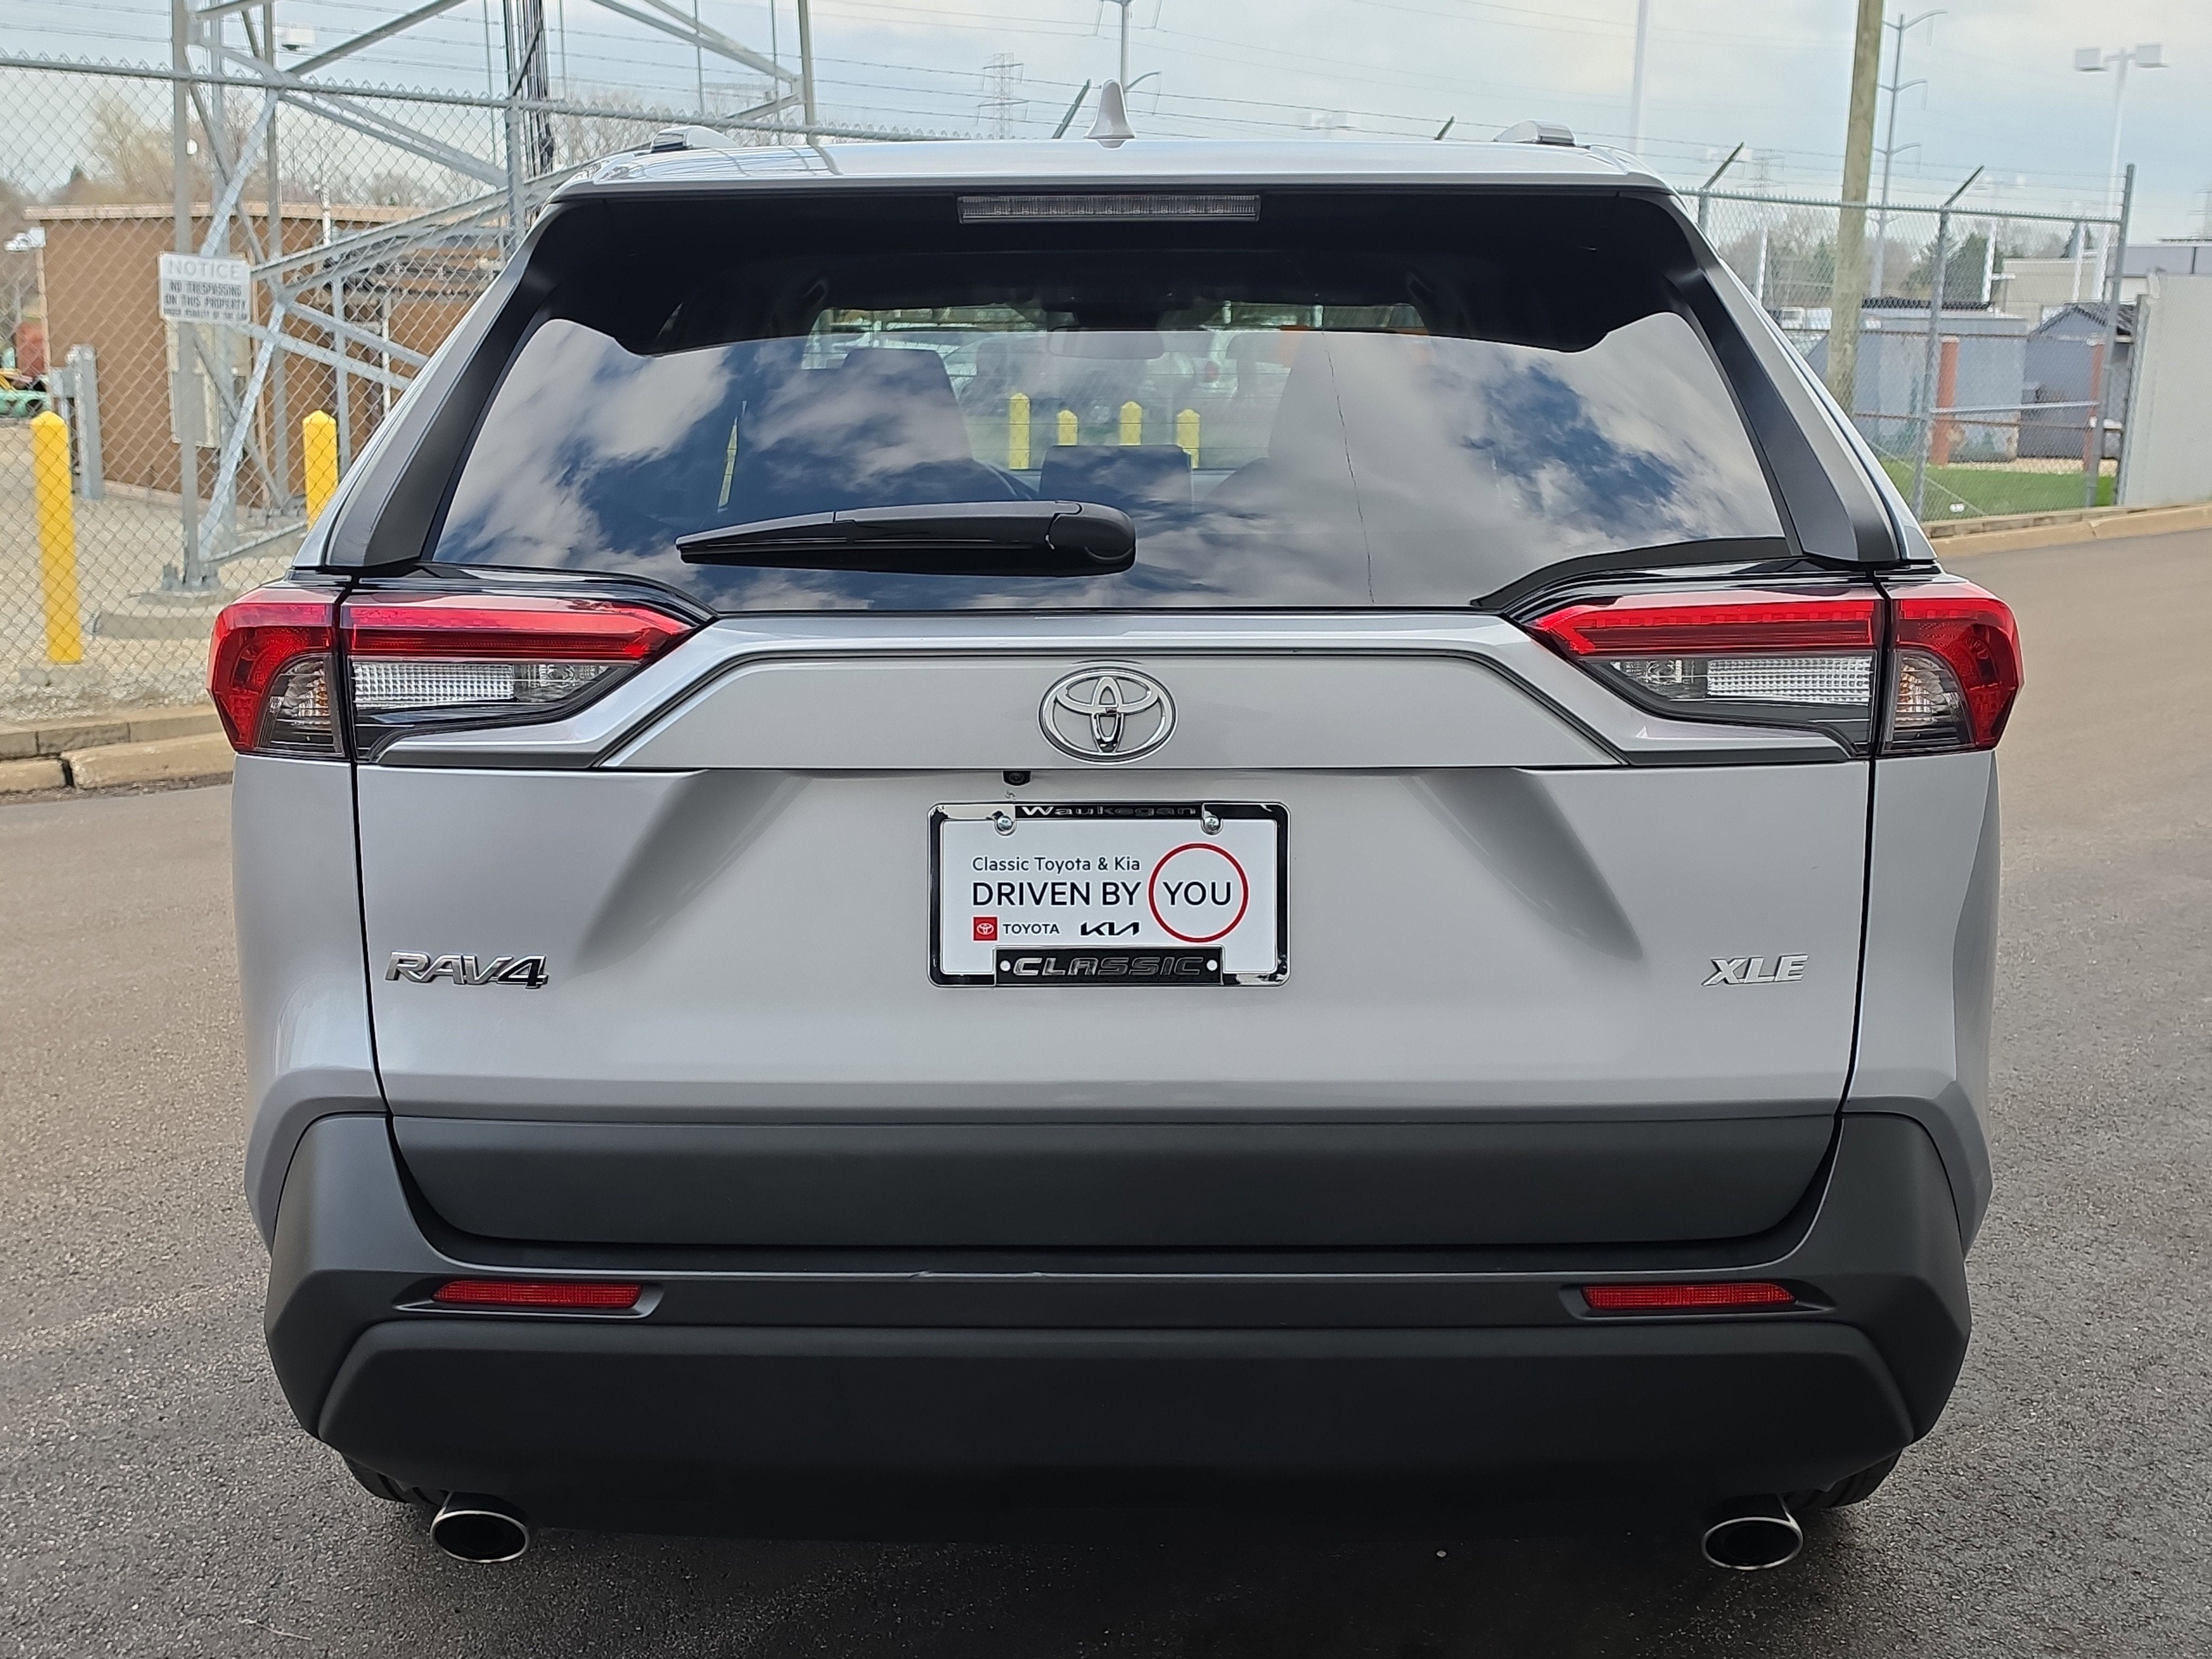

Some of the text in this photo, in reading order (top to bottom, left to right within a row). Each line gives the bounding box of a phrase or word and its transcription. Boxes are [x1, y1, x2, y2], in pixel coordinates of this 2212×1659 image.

[168, 260, 240, 279] NOTICE
[169, 281, 182, 293] NO
[165, 294, 178, 306] ON
[1021, 806, 1196, 816] Waukegan
[973, 856, 1140, 874] Classic Toyota & Kia
[973, 882, 1231, 905] DRIVEN BY YOU
[1002, 924, 1060, 934] TOYOTA
[385, 951, 549, 989] RAV4
[1013, 957, 1204, 976] CLASSIC
[1701, 954, 1809, 986] XLE
